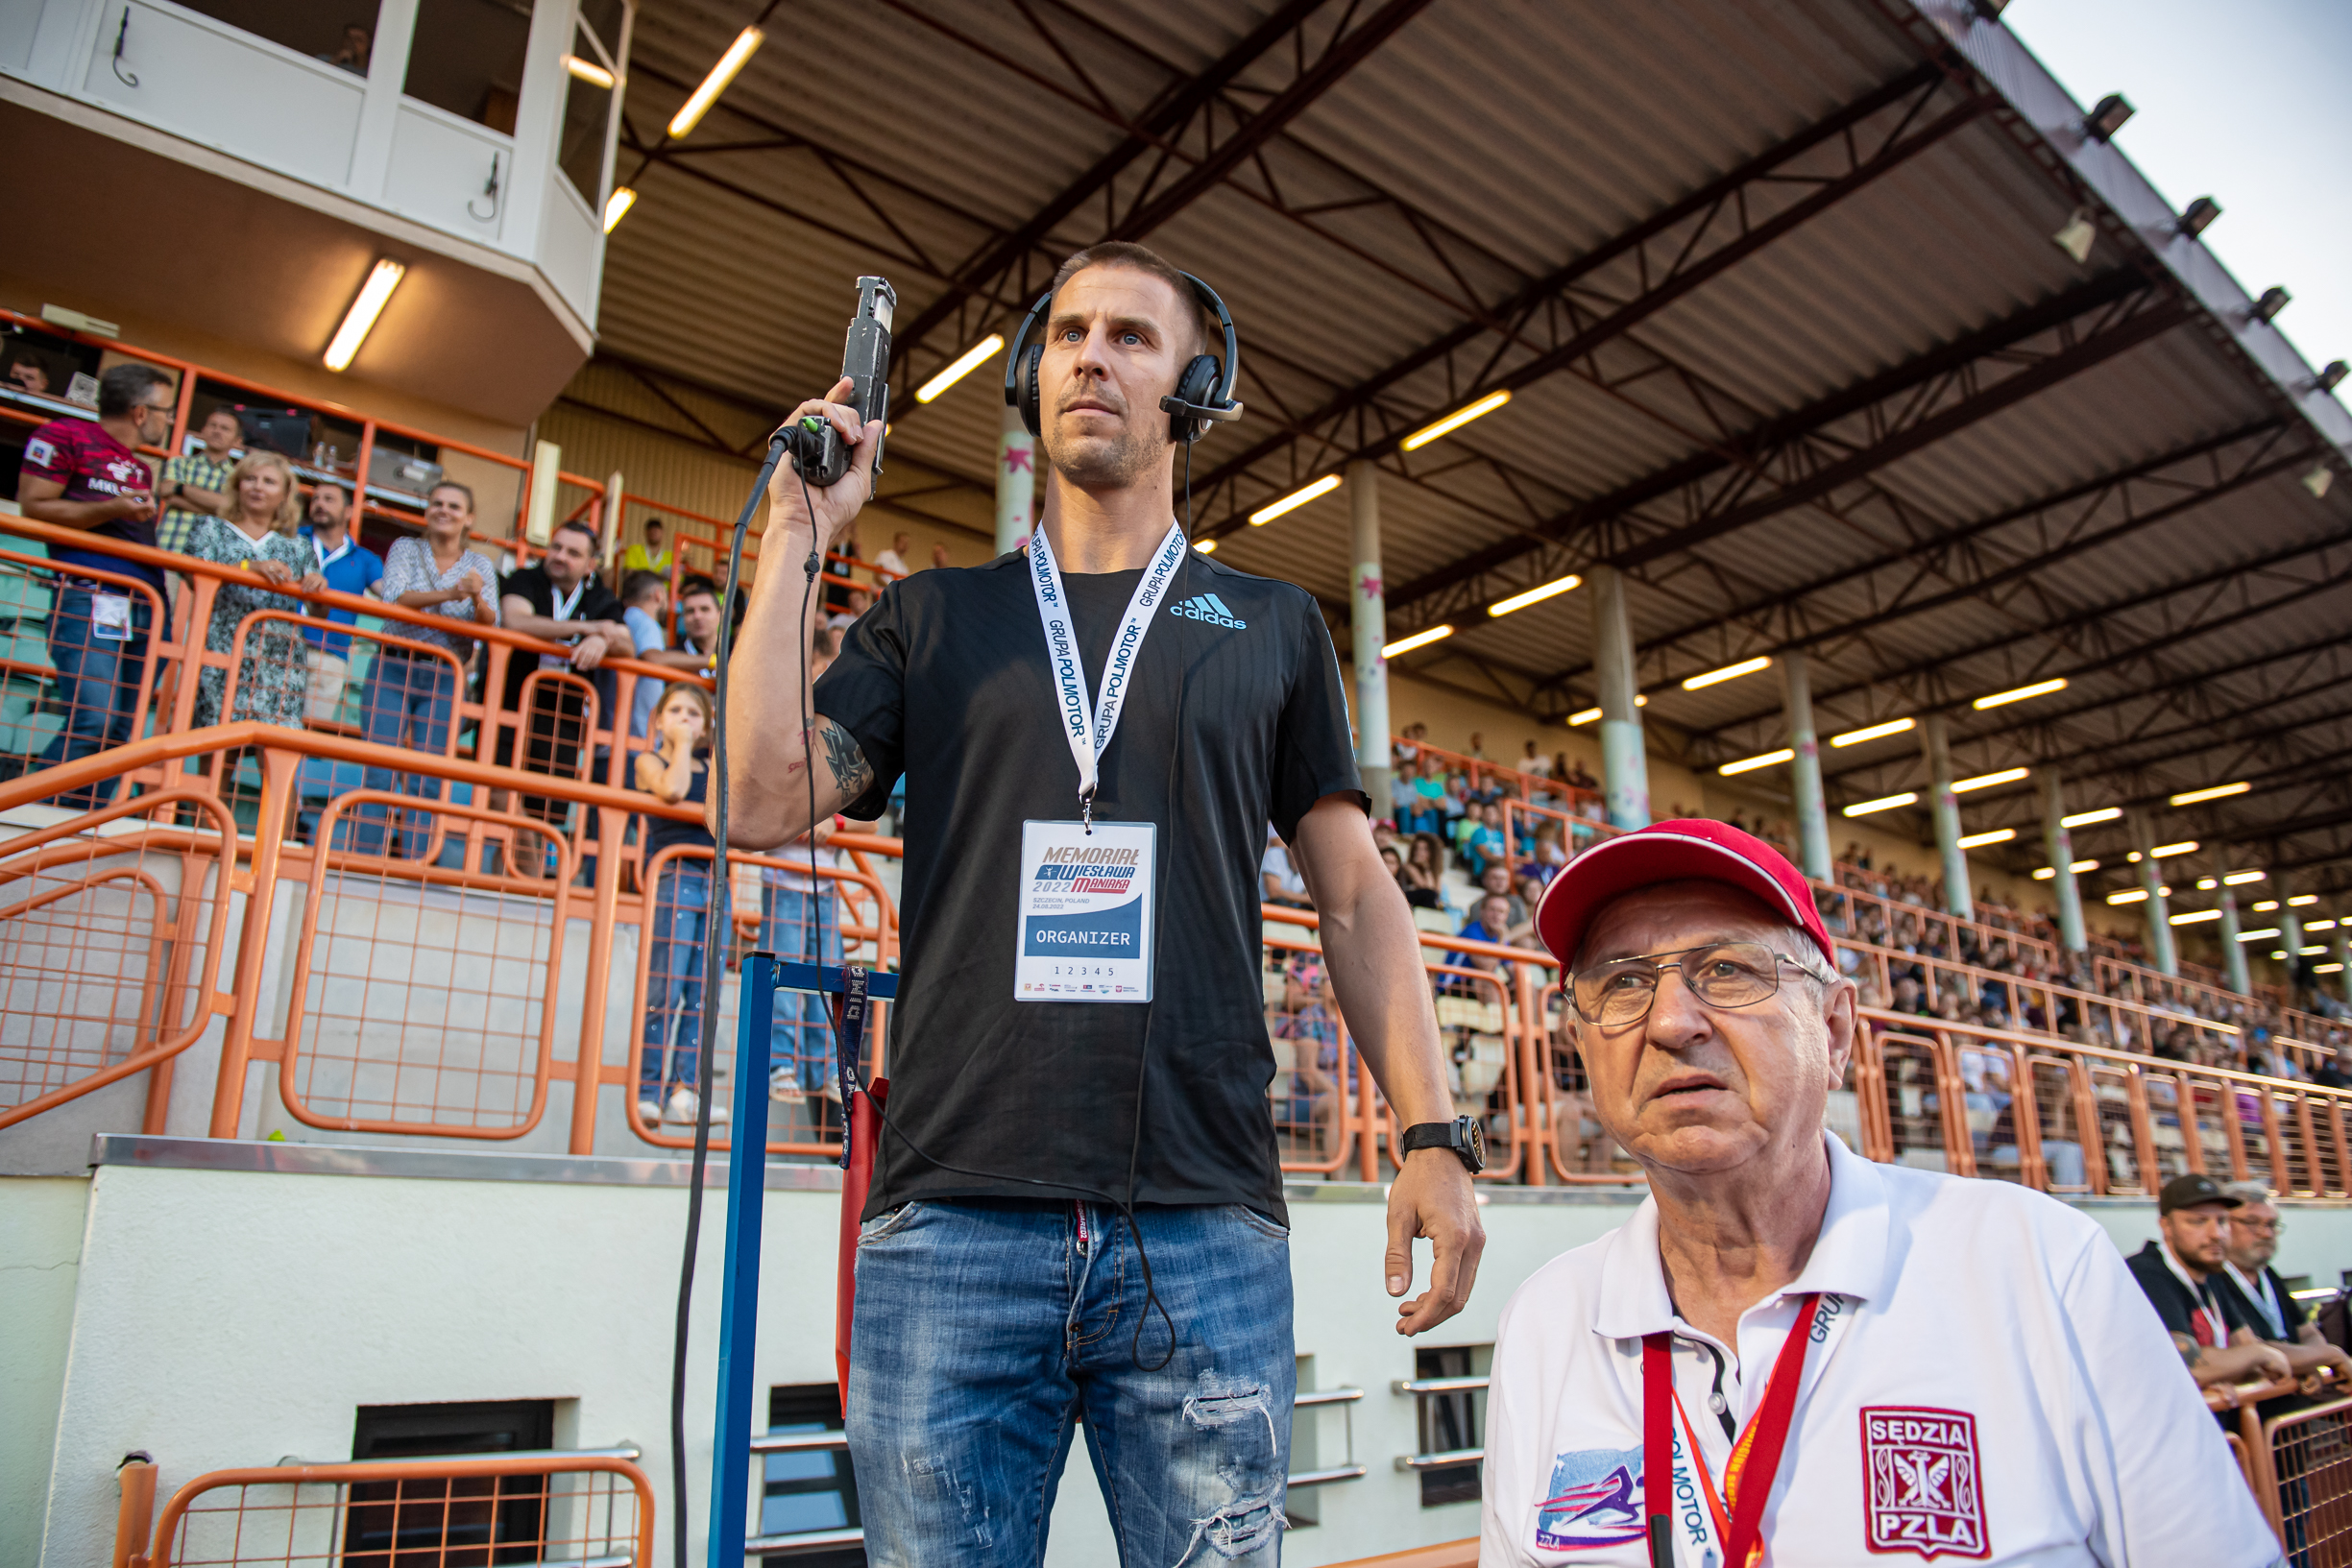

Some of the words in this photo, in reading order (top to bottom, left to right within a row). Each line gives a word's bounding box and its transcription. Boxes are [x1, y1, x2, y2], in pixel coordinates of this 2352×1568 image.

[1034, 550, 1056, 603] POLMOTOR
[1139, 576, 1164, 607] GRUPA
[1170, 604, 1247, 630] adidas
[1049, 619, 1071, 658] GRUPA
[1106, 624, 1142, 698] POLMOTOR
[1057, 658, 1085, 738] POLMOTOR
[1095, 700, 1118, 750] GRUPA
[1042, 846, 1140, 866] MEMORIAŁ
[1032, 880, 1072, 893] 2022
[1058, 864, 1136, 880] WIESŁAWA
[1070, 877, 1131, 893] MANIAKA
[1035, 929, 1131, 946] ORGANIZER
[1068, 966, 1074, 976] 2
[1081, 967, 1087, 976] 3
[1094, 967, 1101, 977] 4
[1107, 967, 1114, 977] 5
[1871, 1419, 1967, 1448] SĘDZIA
[1879, 1513, 1976, 1547] PZLA
